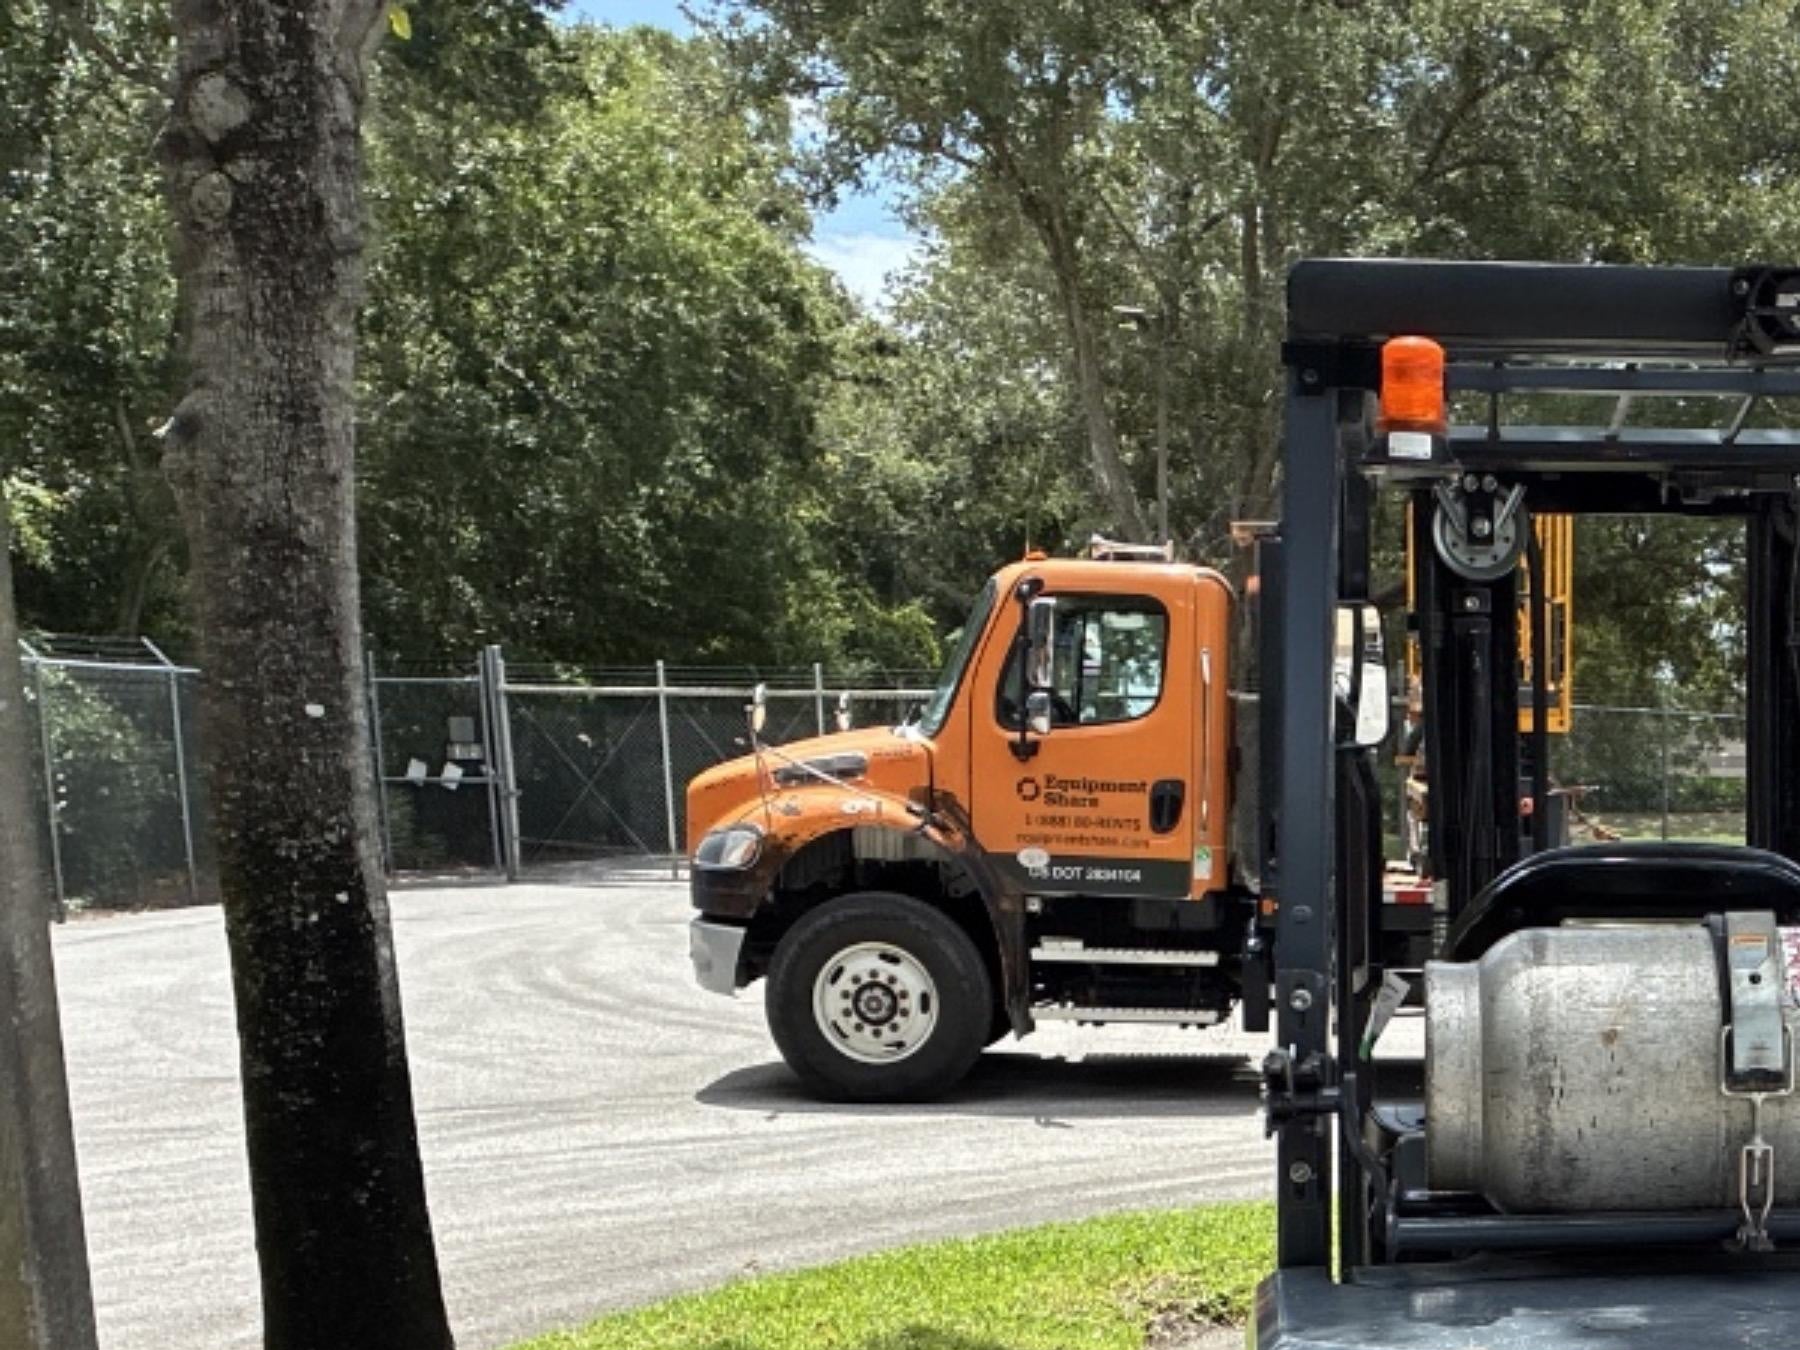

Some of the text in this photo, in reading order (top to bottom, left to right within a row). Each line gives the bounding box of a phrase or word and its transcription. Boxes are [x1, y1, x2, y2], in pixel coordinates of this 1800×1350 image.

[1043, 774, 1147, 793] Equipment
[1043, 792, 1099, 808] Share
[1052, 867, 1083, 880] DOT
